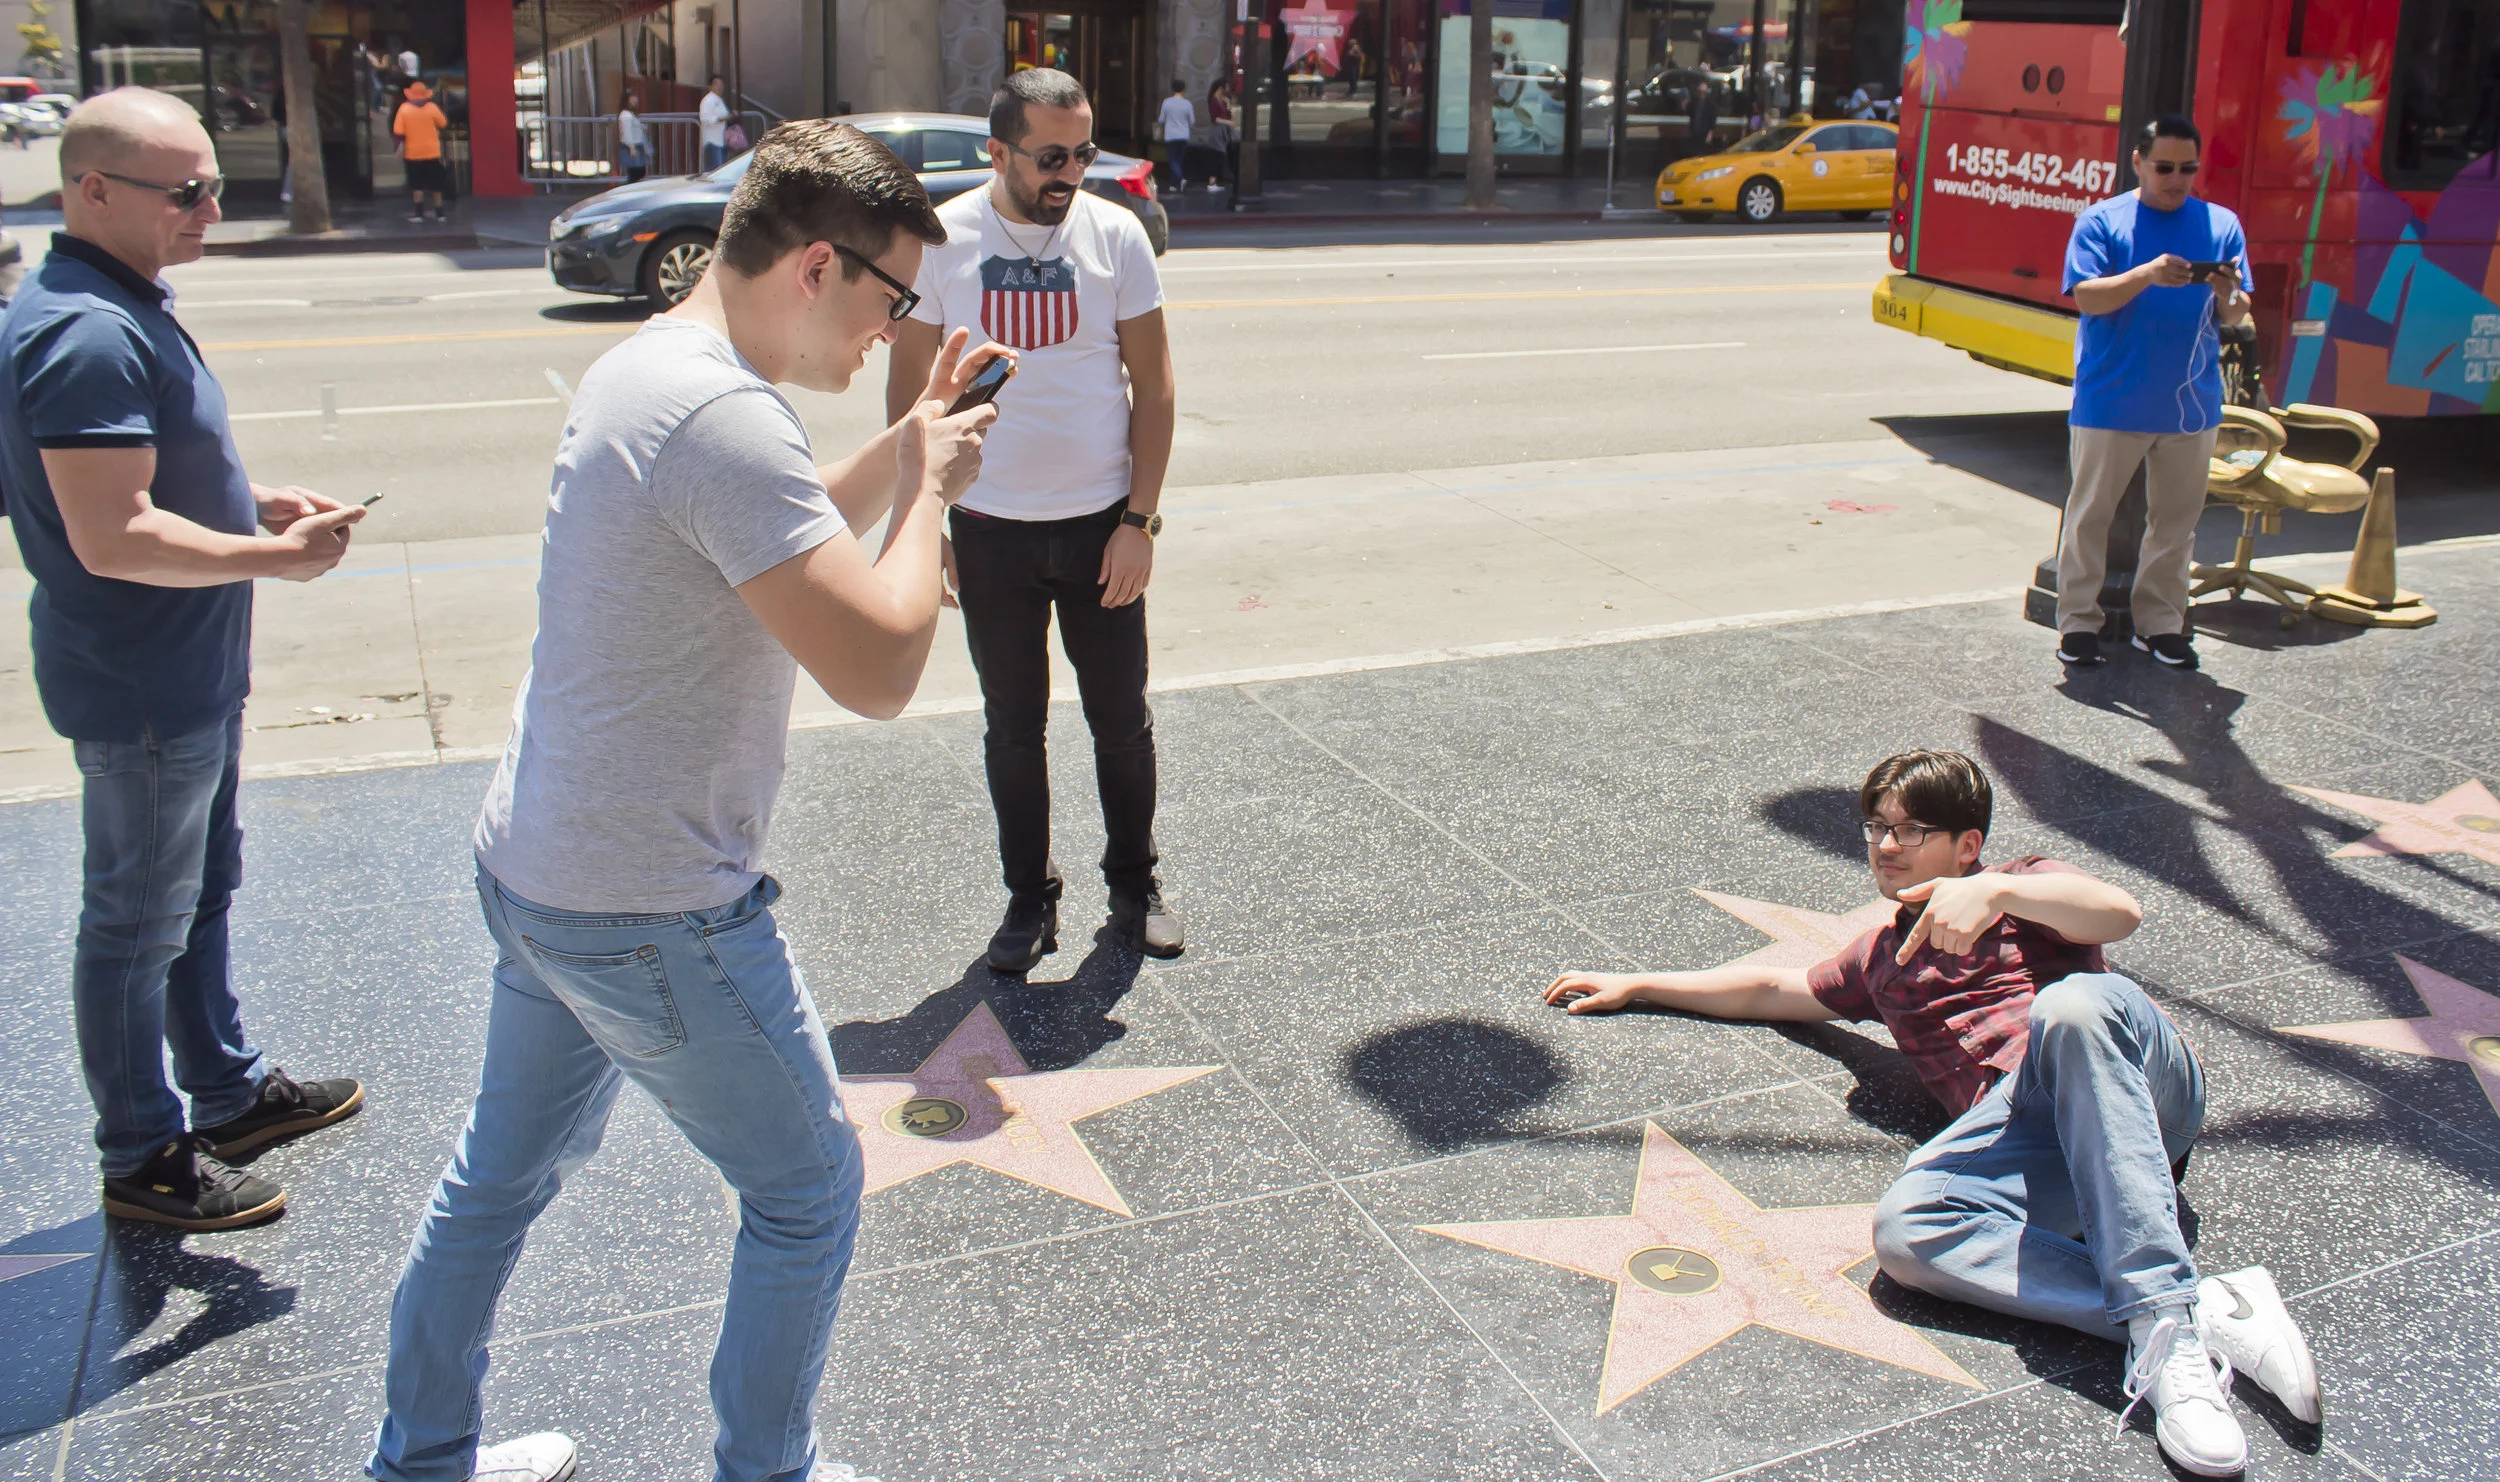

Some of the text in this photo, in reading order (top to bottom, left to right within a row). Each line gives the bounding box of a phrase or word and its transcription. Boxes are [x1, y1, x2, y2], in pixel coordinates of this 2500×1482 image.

[1001, 266, 1058, 286] A & F
[1880, 299, 1906, 321] 304
[1667, 1187, 1849, 1319] DONALD TRUMP
